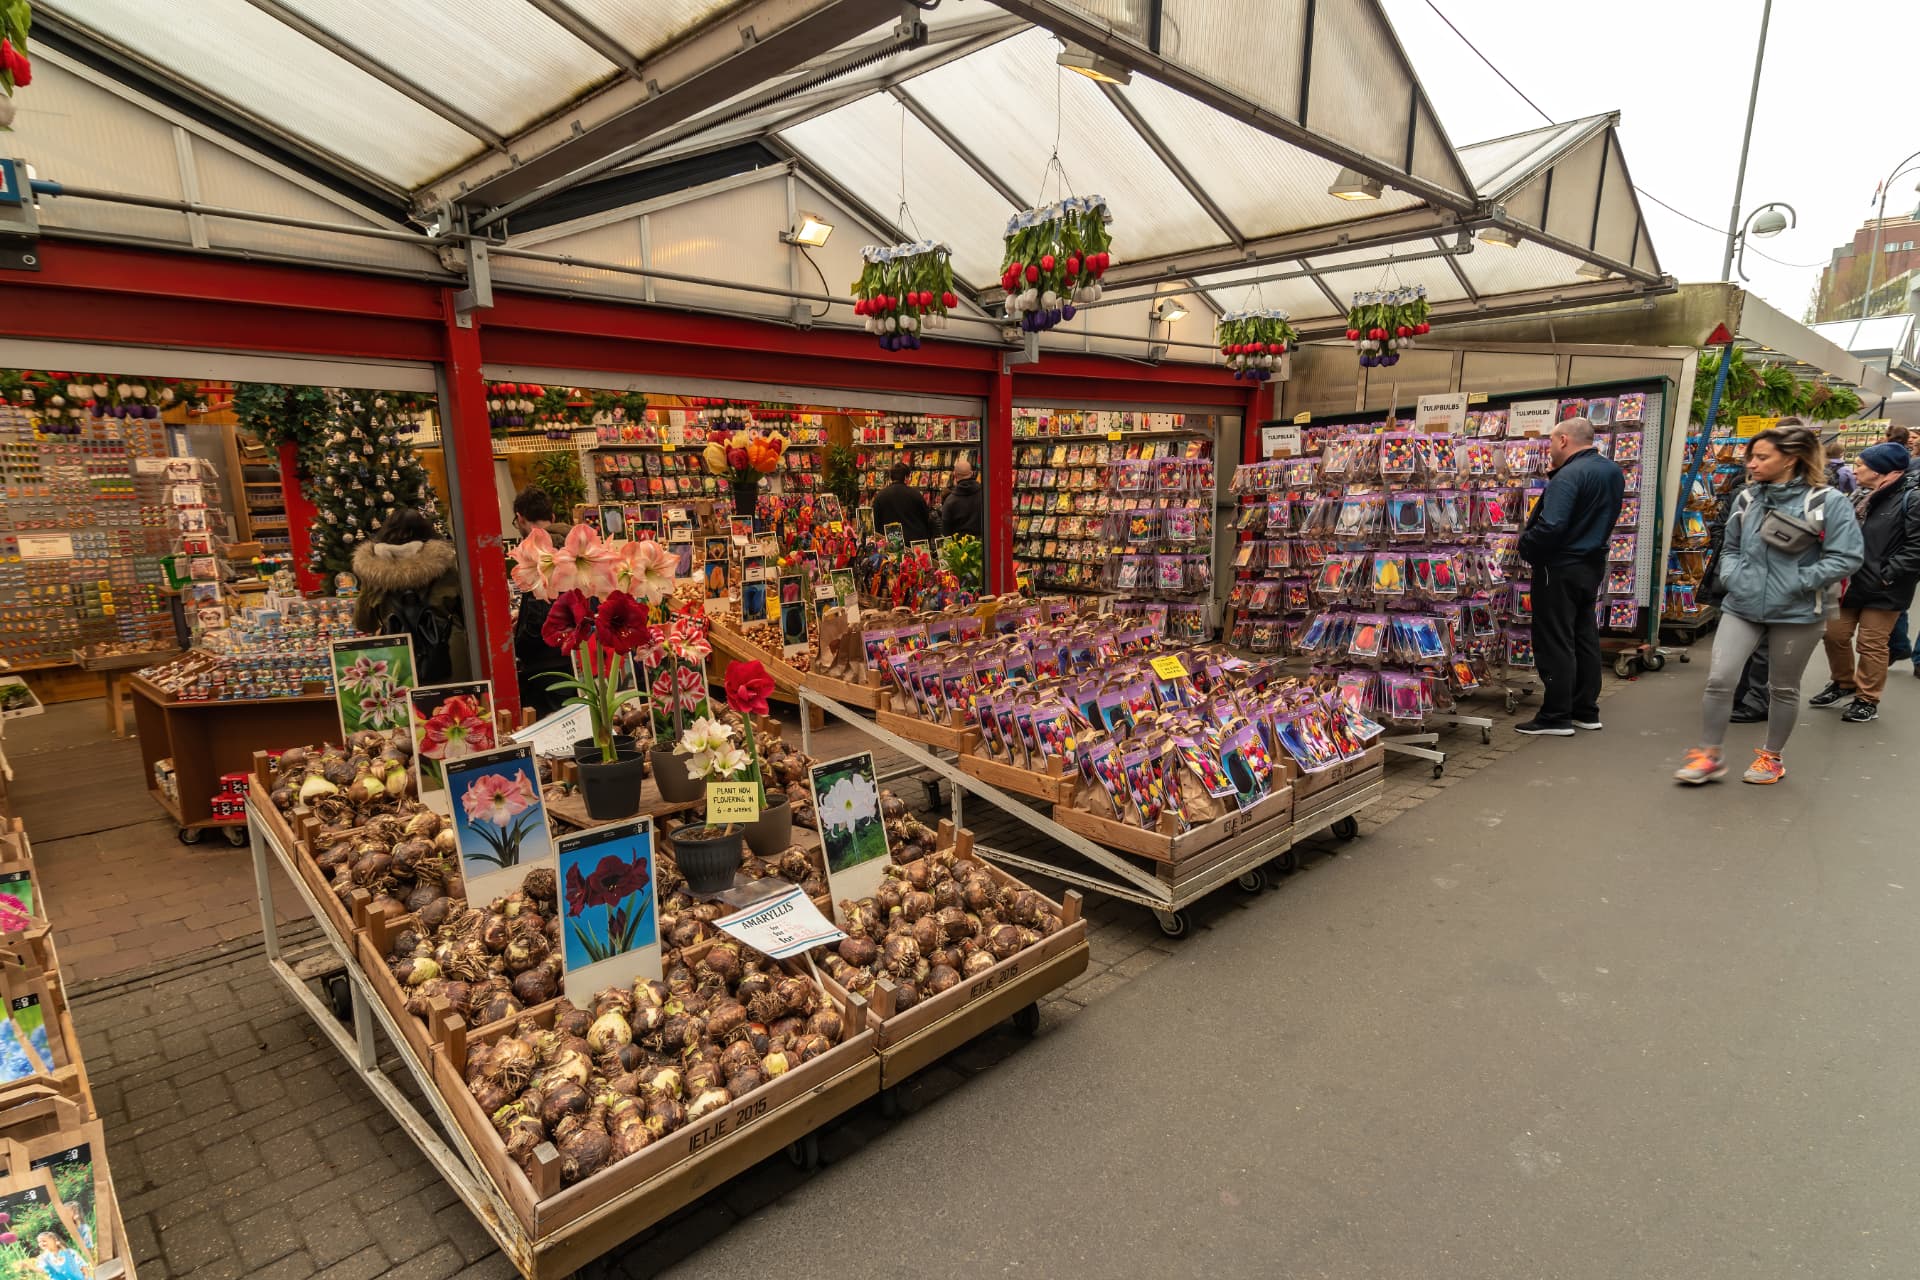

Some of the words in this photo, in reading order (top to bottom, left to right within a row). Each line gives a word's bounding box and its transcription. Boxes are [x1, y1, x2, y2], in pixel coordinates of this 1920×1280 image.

[713, 796, 746, 804] FLOWERING
[716, 787, 736, 795] PLANT
[741, 901, 794, 930] AMARYLLIS
[689, 1118, 727, 1153] IETJE
[736, 1097, 767, 1127] 2015
